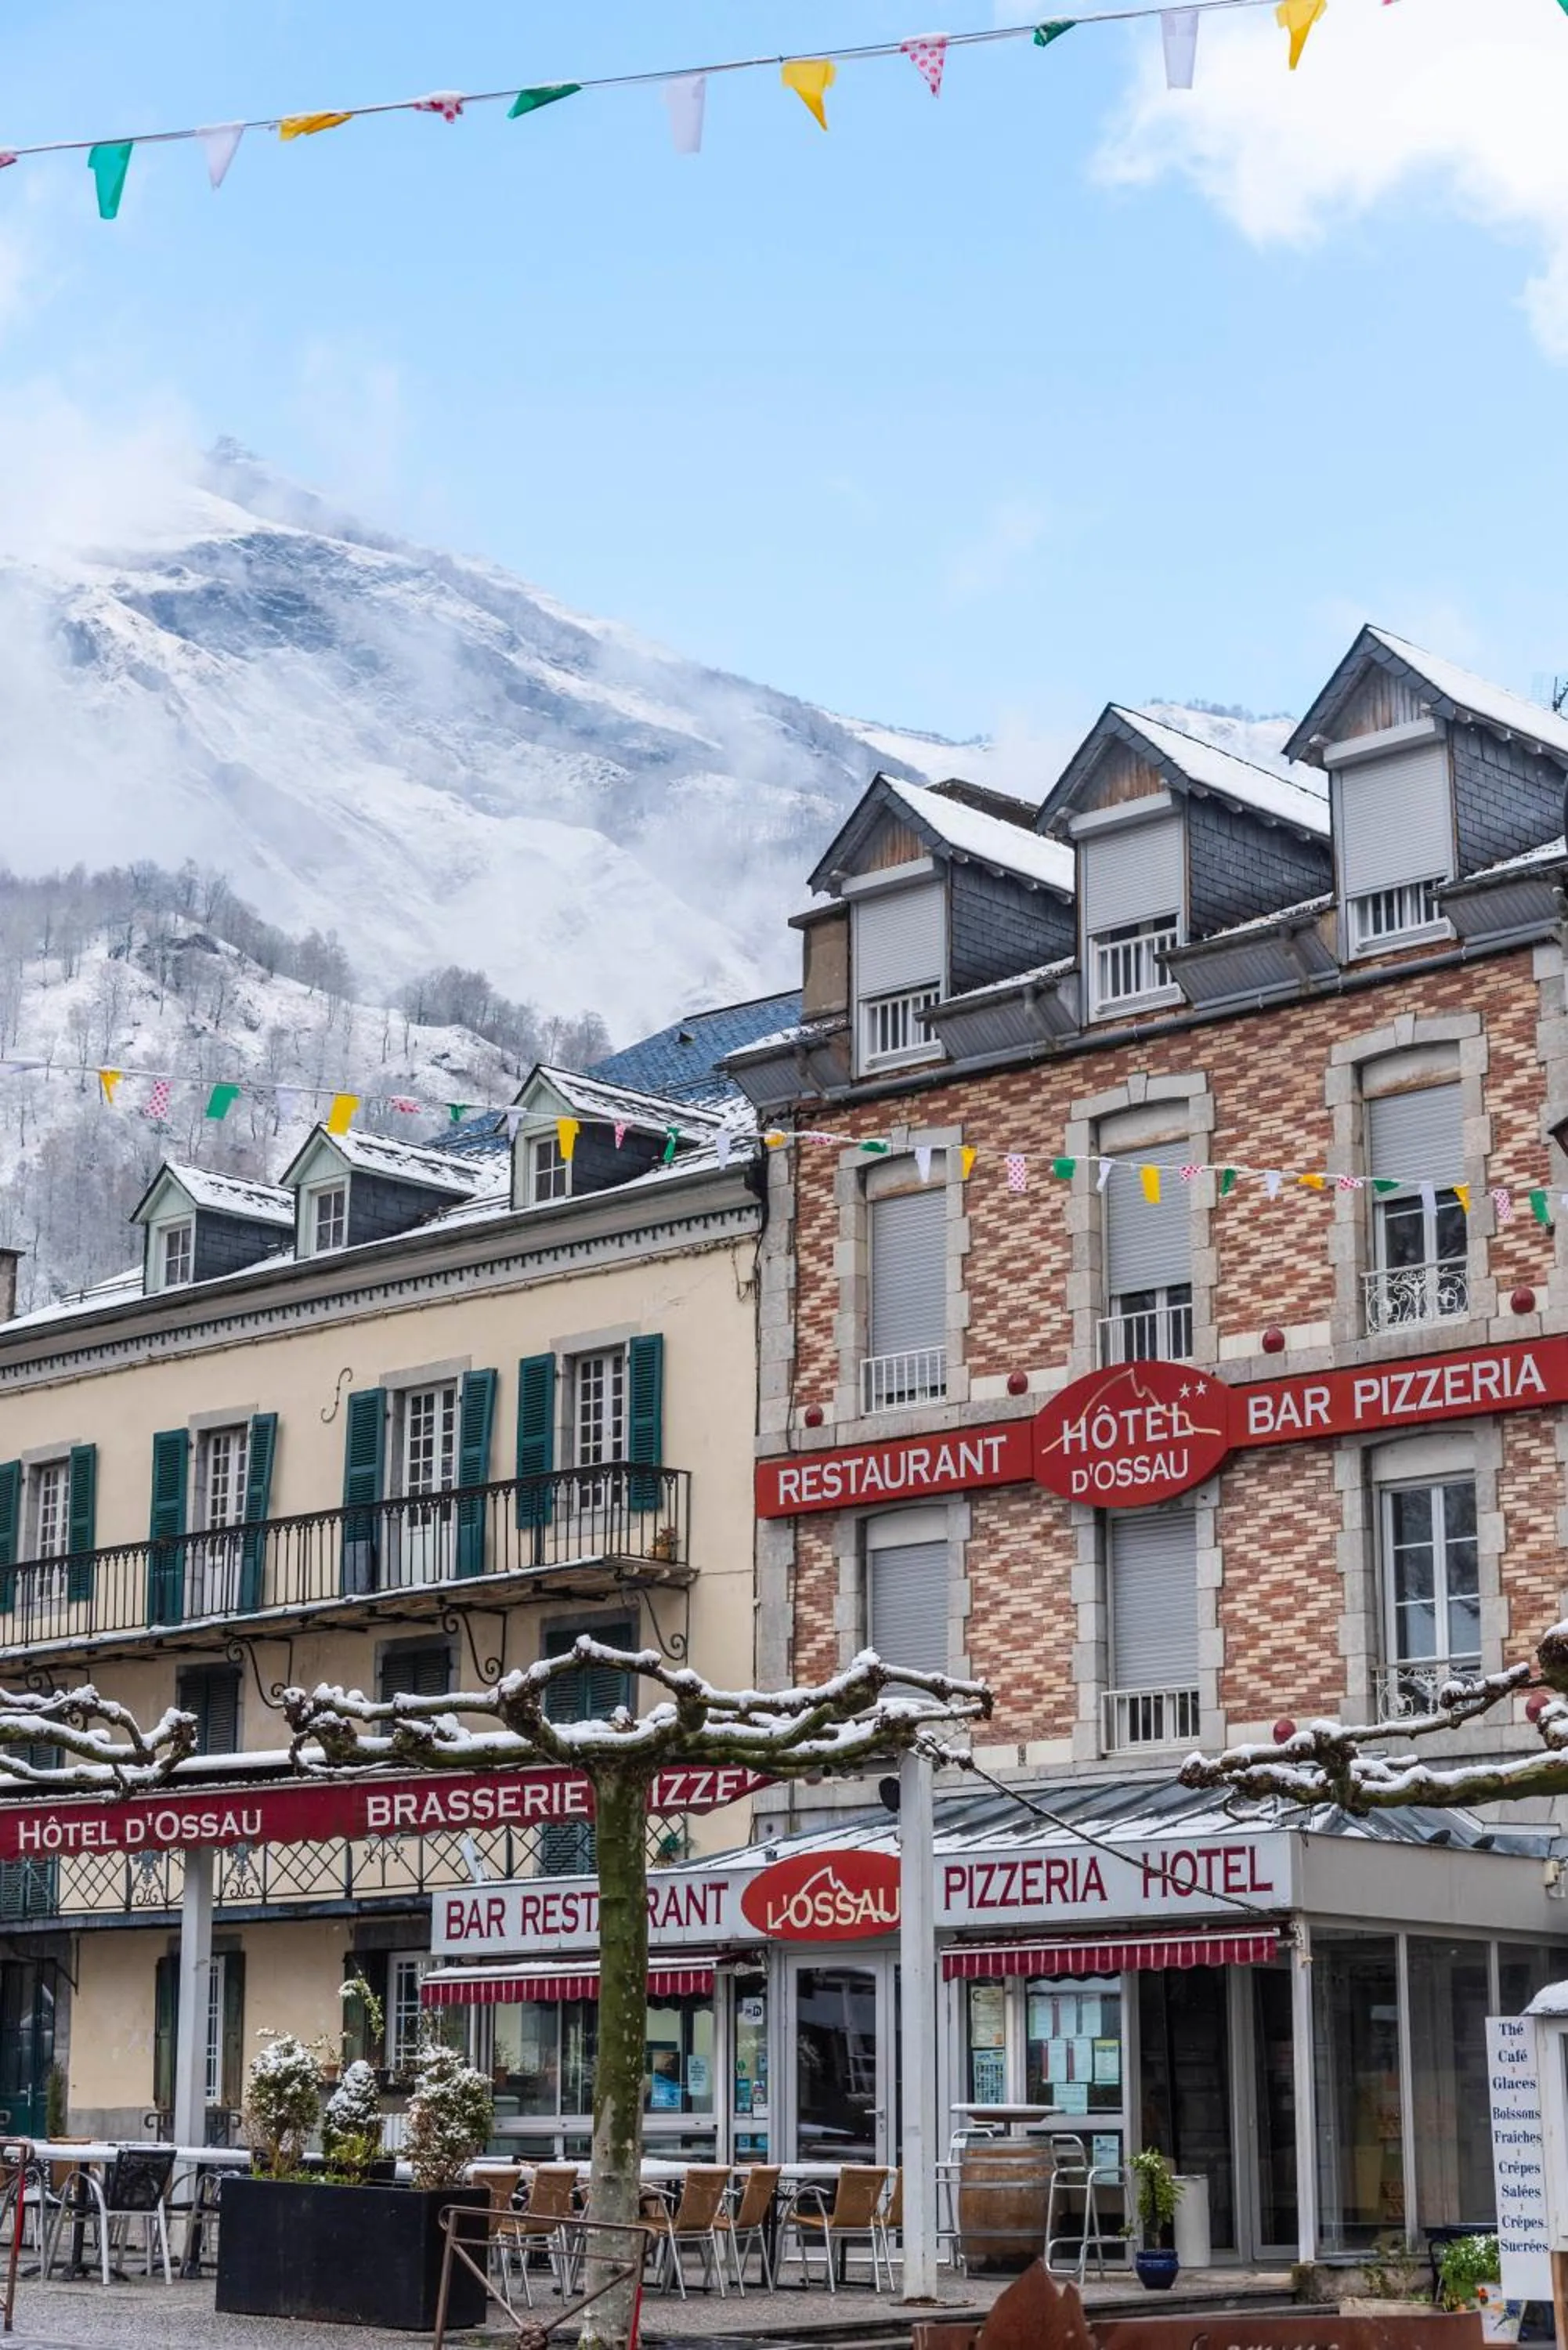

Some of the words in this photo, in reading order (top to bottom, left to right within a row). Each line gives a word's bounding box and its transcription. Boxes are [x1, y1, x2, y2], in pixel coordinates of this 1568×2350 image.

[1248, 1384, 1331, 1436] BAR
[1353, 1354, 1546, 1420] PIZZERIA
[1063, 1402, 1195, 1455] HÔTEL
[778, 1436, 1009, 1506] RESTAURANT
[1071, 1449, 1188, 1495] D'OSSAU
[367, 1780, 588, 1828] BRASSERIE
[18, 1815, 117, 1850] HÔTEL
[945, 1856, 1107, 1910] PIZZERIA
[1142, 1846, 1274, 1898] HOTEL
[446, 1897, 506, 1940] BAR
[521, 1882, 728, 1935] RESTRANT
[768, 1886, 900, 1929] L'OSSAU
[1498, 2022, 1523, 2036] Thé
[1498, 2048, 1527, 2063] Café
[1493, 2076, 1537, 2090] Glaces
[1493, 2106, 1541, 2120] Boissons
[1501, 2182, 1541, 2198] Salées
[1500, 2238, 1548, 2254] Sucrées
